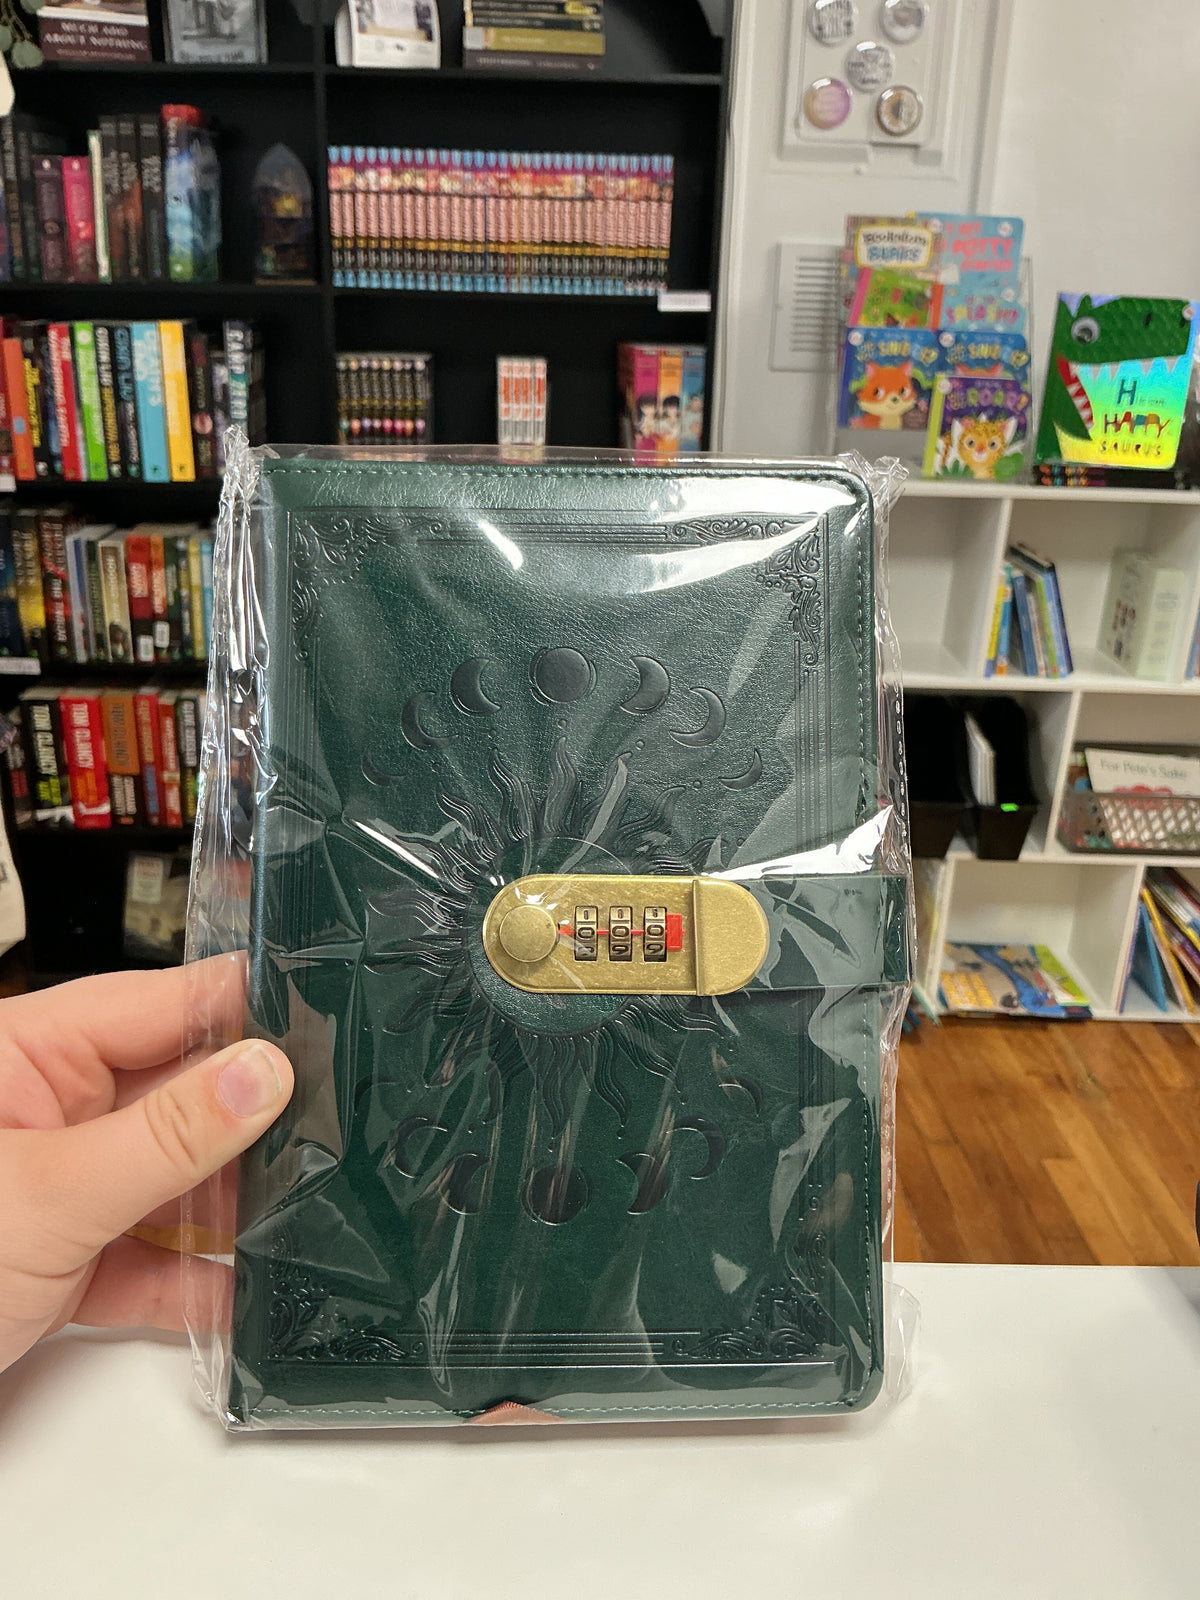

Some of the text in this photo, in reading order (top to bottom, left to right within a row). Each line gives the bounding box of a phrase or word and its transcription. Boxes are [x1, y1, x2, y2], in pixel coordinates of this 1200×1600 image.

[951, 237, 1014, 258] POTTY
[118, 371, 135, 402] LIU
[227, 329, 248, 420] CAMP ZERO
[1117, 378, 1138, 406] H
[1104, 411, 1171, 440] HAPPY
[71, 703, 90, 727] TOM
[31, 704, 58, 776] TOM CLANCY
[75, 727, 95, 769] CLANCY
[111, 703, 129, 767] TOM CLANCY
